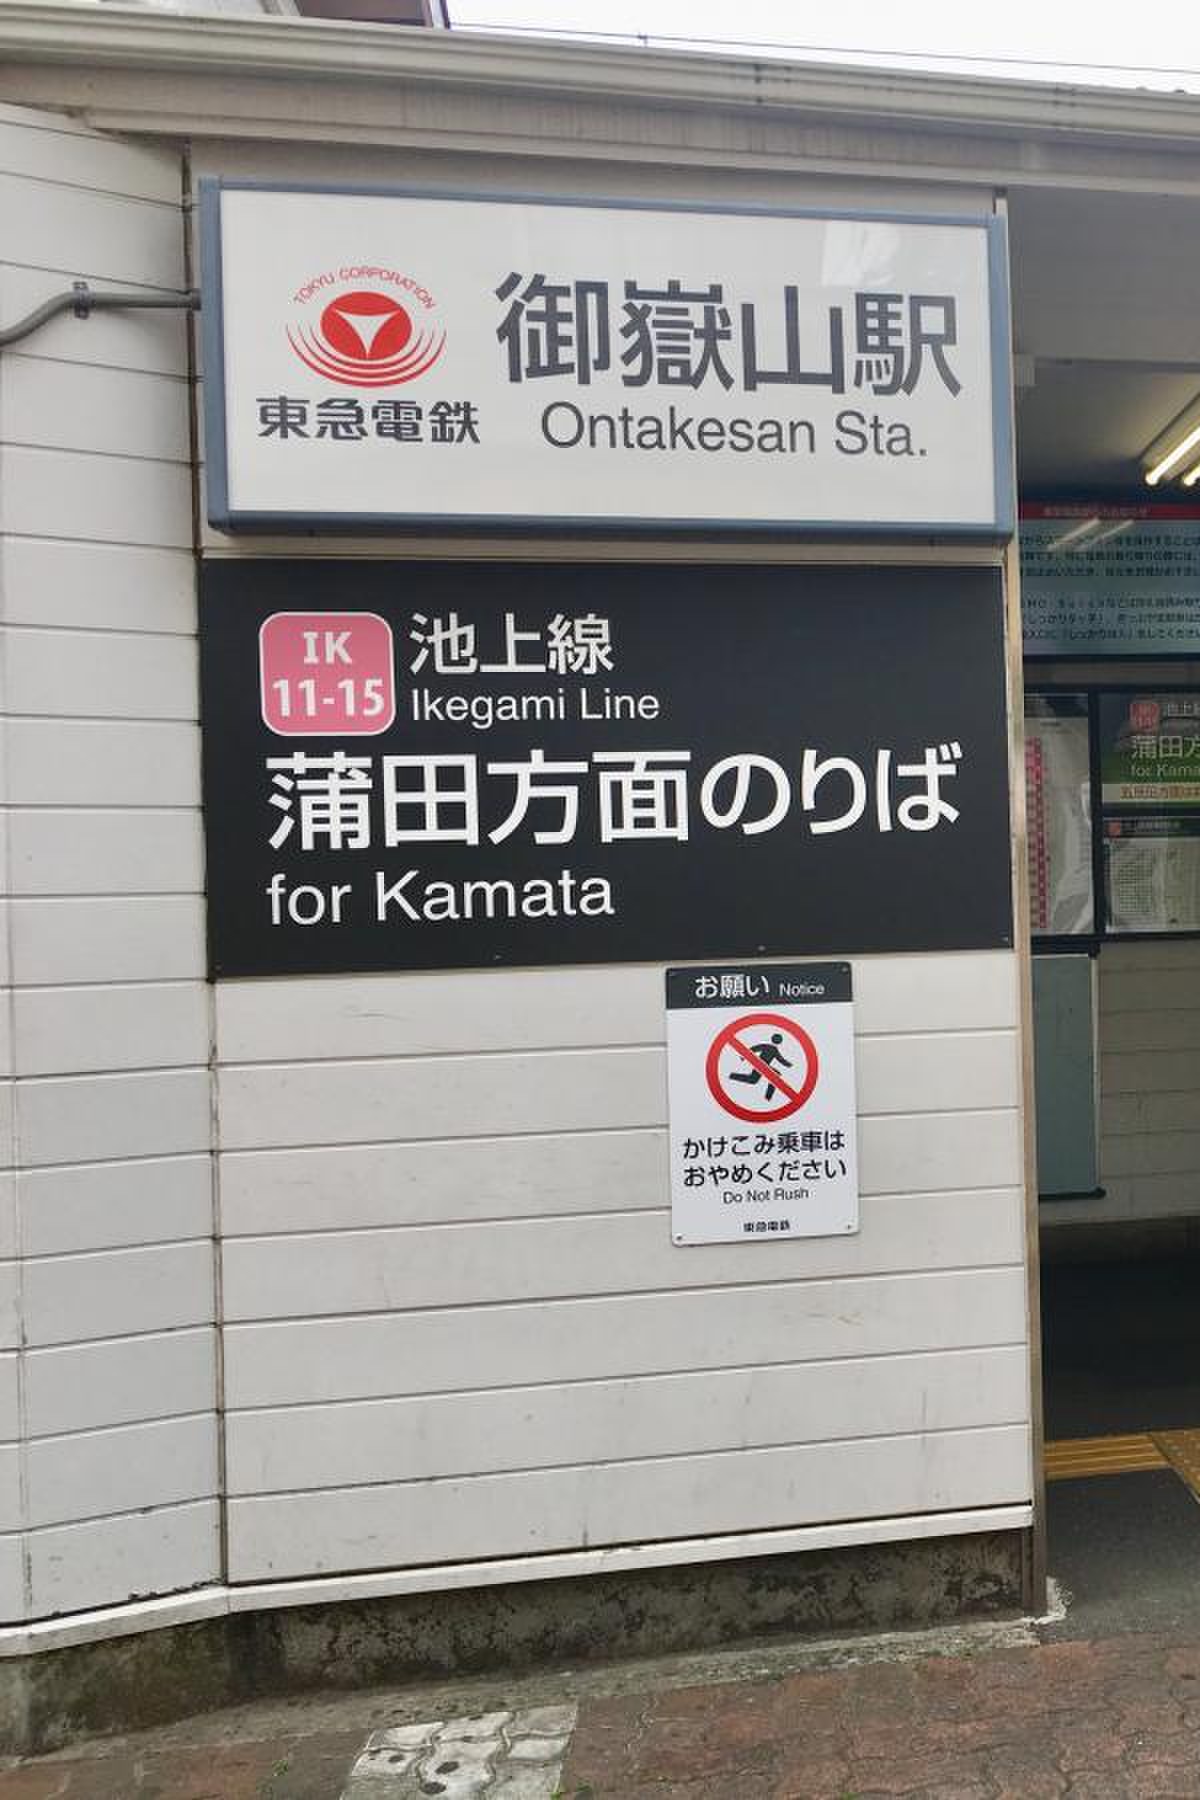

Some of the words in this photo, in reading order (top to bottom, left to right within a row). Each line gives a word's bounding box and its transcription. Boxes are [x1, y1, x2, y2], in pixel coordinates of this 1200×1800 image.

[293, 272, 335, 305] TOKYU
[339, 265, 436, 309] CORPORATION
[496, 271, 961, 398] 御嶽山駅
[255, 395, 481, 444] 東急電鉄
[541, 401, 816, 454] Ontakesan
[835, 409, 928, 457] Sta.
[303, 632, 353, 664] IK
[410, 612, 615, 675] 池上線
[273, 679, 385, 717] 11-15
[412, 687, 565, 730] Ikegami
[580, 687, 660, 721] Line
[266, 740, 963, 851] 蒲田方面のりば
[266, 873, 352, 925] for
[376, 869, 616, 922] Kamata
[695, 974, 770, 999] お願い
[779, 982, 825, 997] Notice
[683, 1130, 846, 1160] かけこみ乗車は
[683, 1159, 847, 1187] おやめください
[723, 1191, 743, 1204] Do
[746, 1188, 770, 1202] Not
[774, 1187, 809, 1201] Rush
